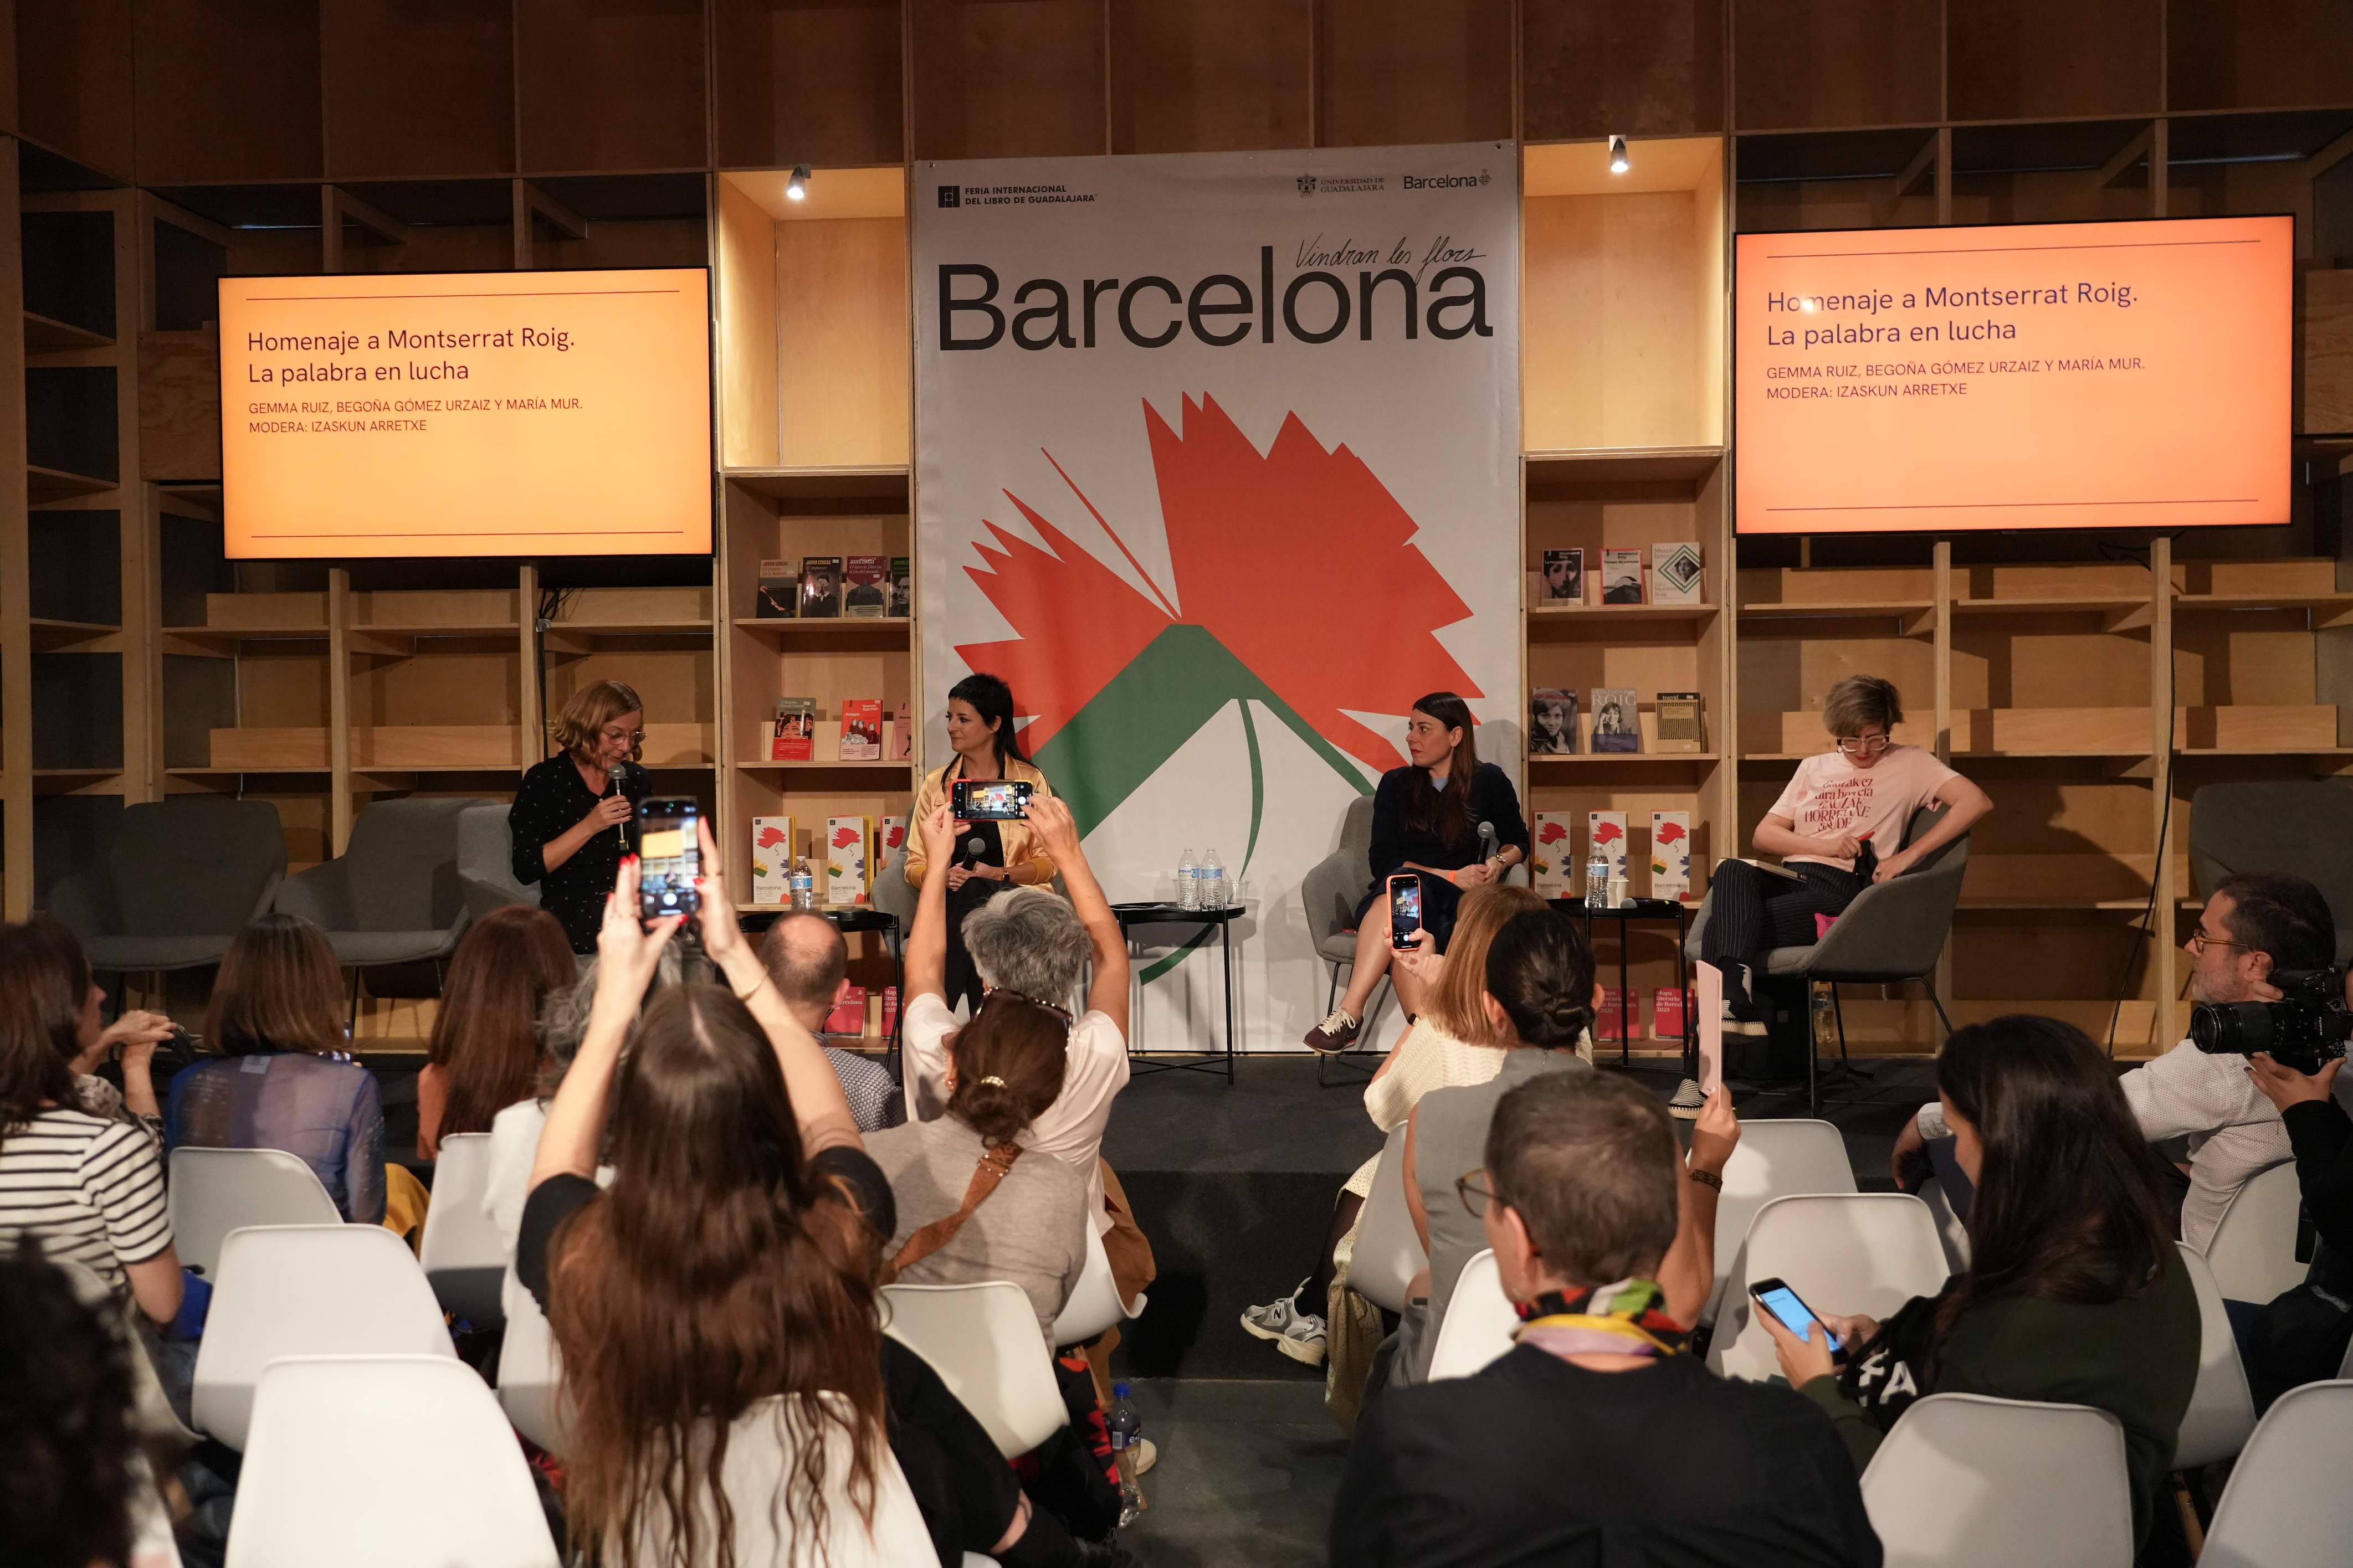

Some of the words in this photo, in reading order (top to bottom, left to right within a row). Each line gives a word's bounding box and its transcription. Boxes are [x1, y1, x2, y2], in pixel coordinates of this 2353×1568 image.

[992, 186, 1067, 194] INTERNACIONAL
[1321, 184, 1385, 193] GUADALAJARA
[1403, 174, 1477, 189] Barcelona
[1028, 194, 1095, 203] GUADALAJARA
[1296, 232, 1379, 268] Vindran
[1386, 237, 1411, 264] les
[1415, 236, 1486, 286] flors
[939, 246, 1493, 351] Barcelona
[1768, 289, 1893, 315] Homenaje
[1902, 294, 1915, 309] a
[1926, 284, 2068, 308] Montserrat
[2078, 281, 2137, 307] Roig.
[248, 330, 360, 356] Homenaje
[367, 336, 380, 349] a
[388, 329, 514, 349] Montserrat
[522, 327, 574, 352] Roig.
[1768, 325, 1795, 346] La
[1805, 322, 1900, 350] palabra
[1910, 326, 1939, 342] en
[1949, 319, 2016, 341] lucha
[249, 363, 273, 383] La
[281, 362, 366, 388] palabra
[375, 366, 401, 381] en
[409, 361, 469, 381] lucha
[1767, 366, 1822, 379] GEMMA
[1827, 365, 1861, 379] RUIZ,
[1866, 361, 1927, 377] BEGOÑA
[1931, 359, 1985, 375] GÓMEZ
[1990, 360, 2040, 373] URZAIZ
[2044, 360, 2054, 372] Y
[2058, 355, 2104, 371] MARÍA
[2109, 357, 2145, 370] MUR.
[1767, 387, 1832, 399] MODERA:
[1837, 385, 1898, 398] IZASKUN
[1902, 383, 1967, 396] ARRETXE
[249, 403, 298, 414] GEMMA
[302, 402, 332, 415] RUIZ,
[337, 398, 391, 413] BEGOÑA
[394, 397, 442, 412] GÓMEZ
[446, 399, 491, 411] URZAIZ
[494, 399, 503, 410] Y
[506, 396, 547, 410] MARÍA
[551, 398, 582, 409] MUR.
[249, 421, 307, 433] MODERA:
[312, 420, 365, 432] IZASKUN
[370, 420, 427, 431] ARRETXE
[1592, 695, 1636, 706] ROIG
